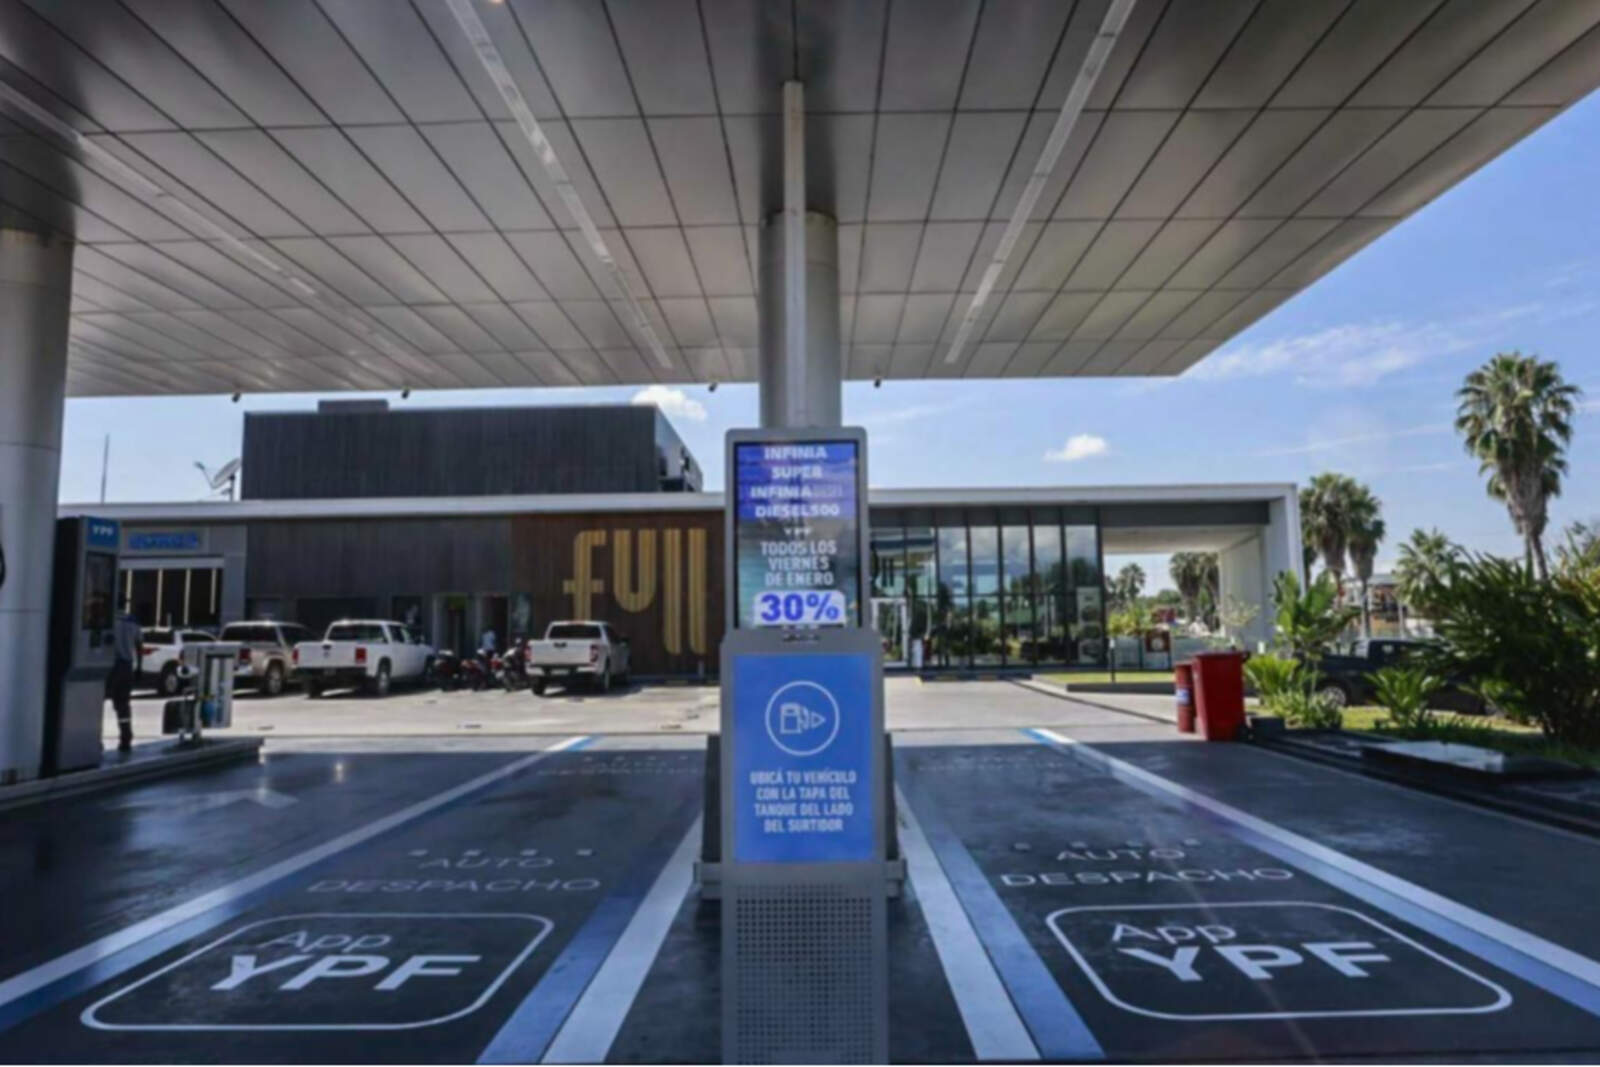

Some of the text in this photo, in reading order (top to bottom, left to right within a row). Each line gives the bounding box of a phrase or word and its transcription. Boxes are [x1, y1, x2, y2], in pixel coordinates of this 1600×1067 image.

[764, 446, 827, 459] INFINIA
[771, 465, 822, 479] SUPER
[750, 485, 812, 499] INFINIA
[760, 540, 837, 556] TODOS LOS
[768, 556, 829, 570] VIERNES
[765, 572, 834, 587] DE ENERO
[760, 593, 840, 622] 30%
[786, 771, 801, 785] TU
[755, 786, 850, 800] CON LA TAPA DEL
[754, 802, 854, 816] TANQUE DEL LADO
[763, 818, 843, 833] DEL SURTIDOR
[1057, 848, 1185, 862] AUTO
[418, 857, 555, 869] AUTO
[1001, 868, 1294, 887] DESPACHO
[306, 879, 600, 893] DESPACHO
[255, 929, 391, 953] App
[1111, 924, 1237, 945] App
[1117, 942, 1392, 983] YPF
[209, 954, 483, 991] YPF
